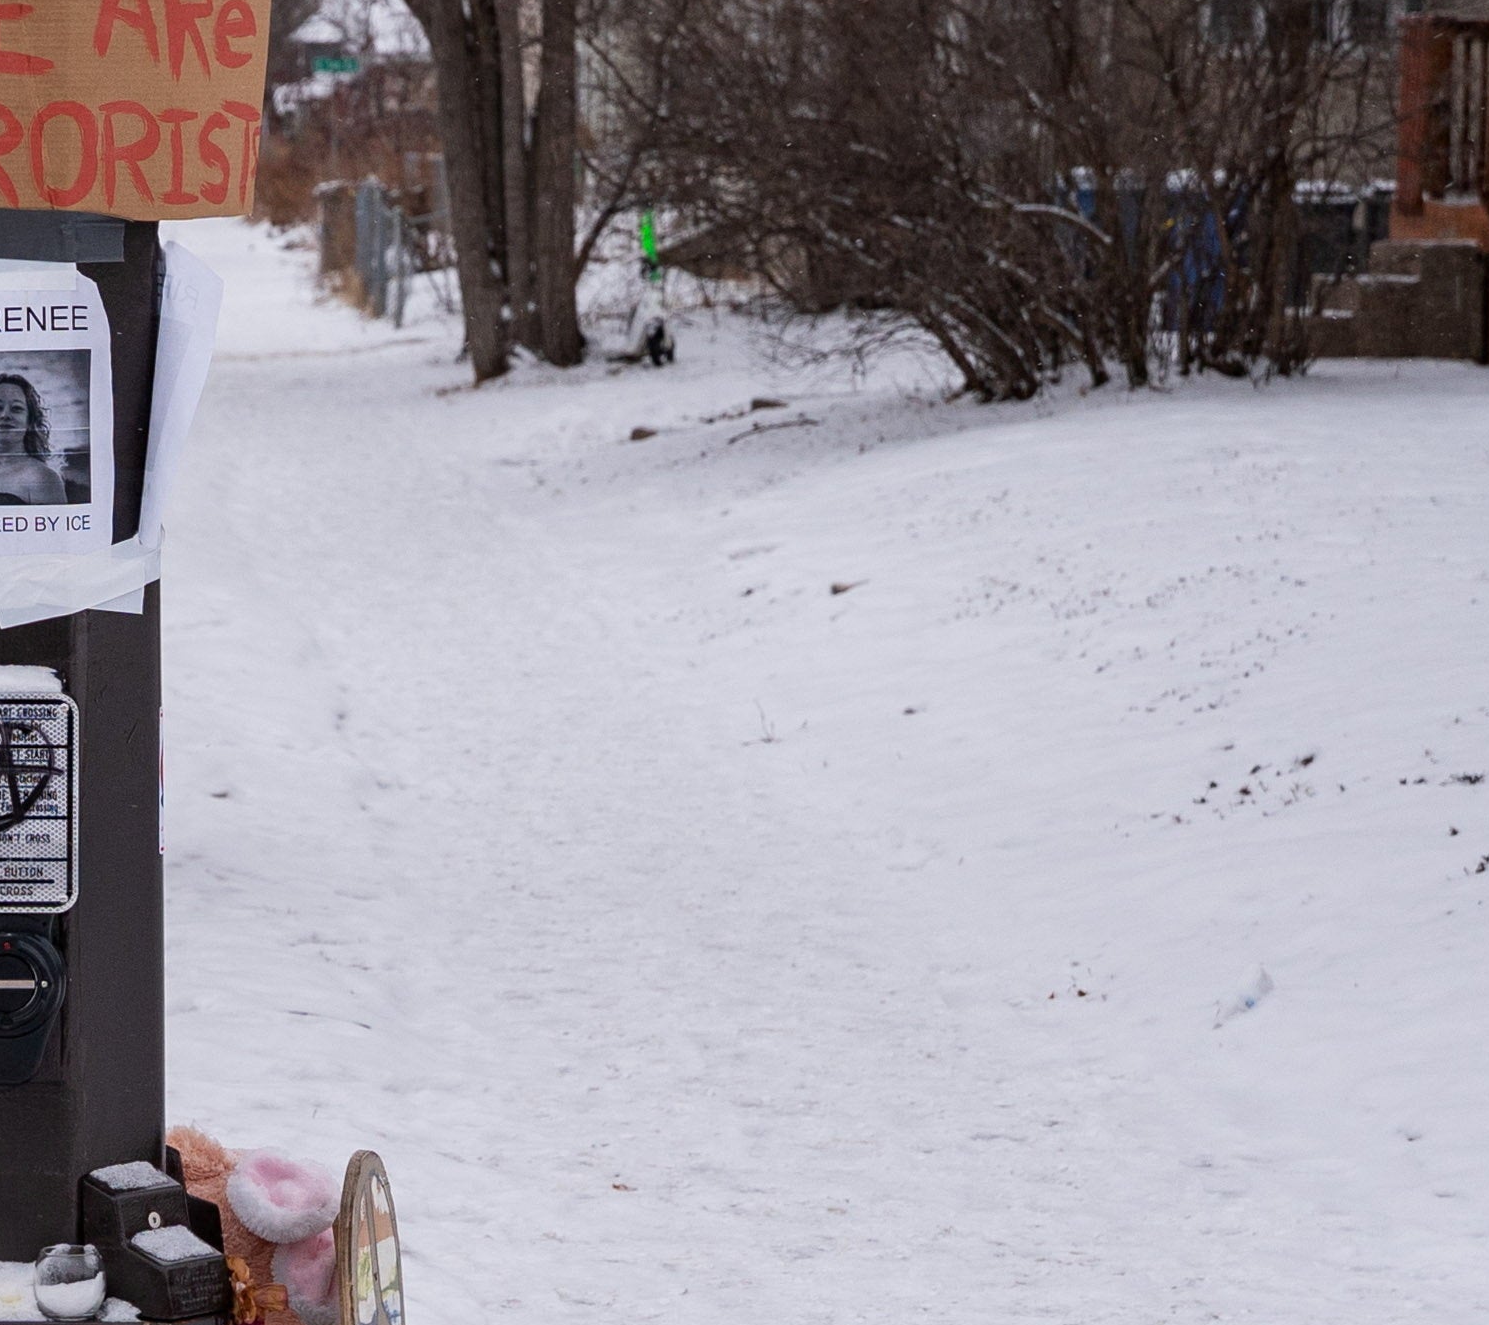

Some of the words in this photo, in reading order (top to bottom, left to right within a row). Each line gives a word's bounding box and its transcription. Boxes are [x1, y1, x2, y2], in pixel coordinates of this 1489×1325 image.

[35, 517, 60, 532] BY
[66, 515, 91, 530] ICE
[4, 867, 44, 876] BUTTON
[0, 886, 33, 896] CROSS
